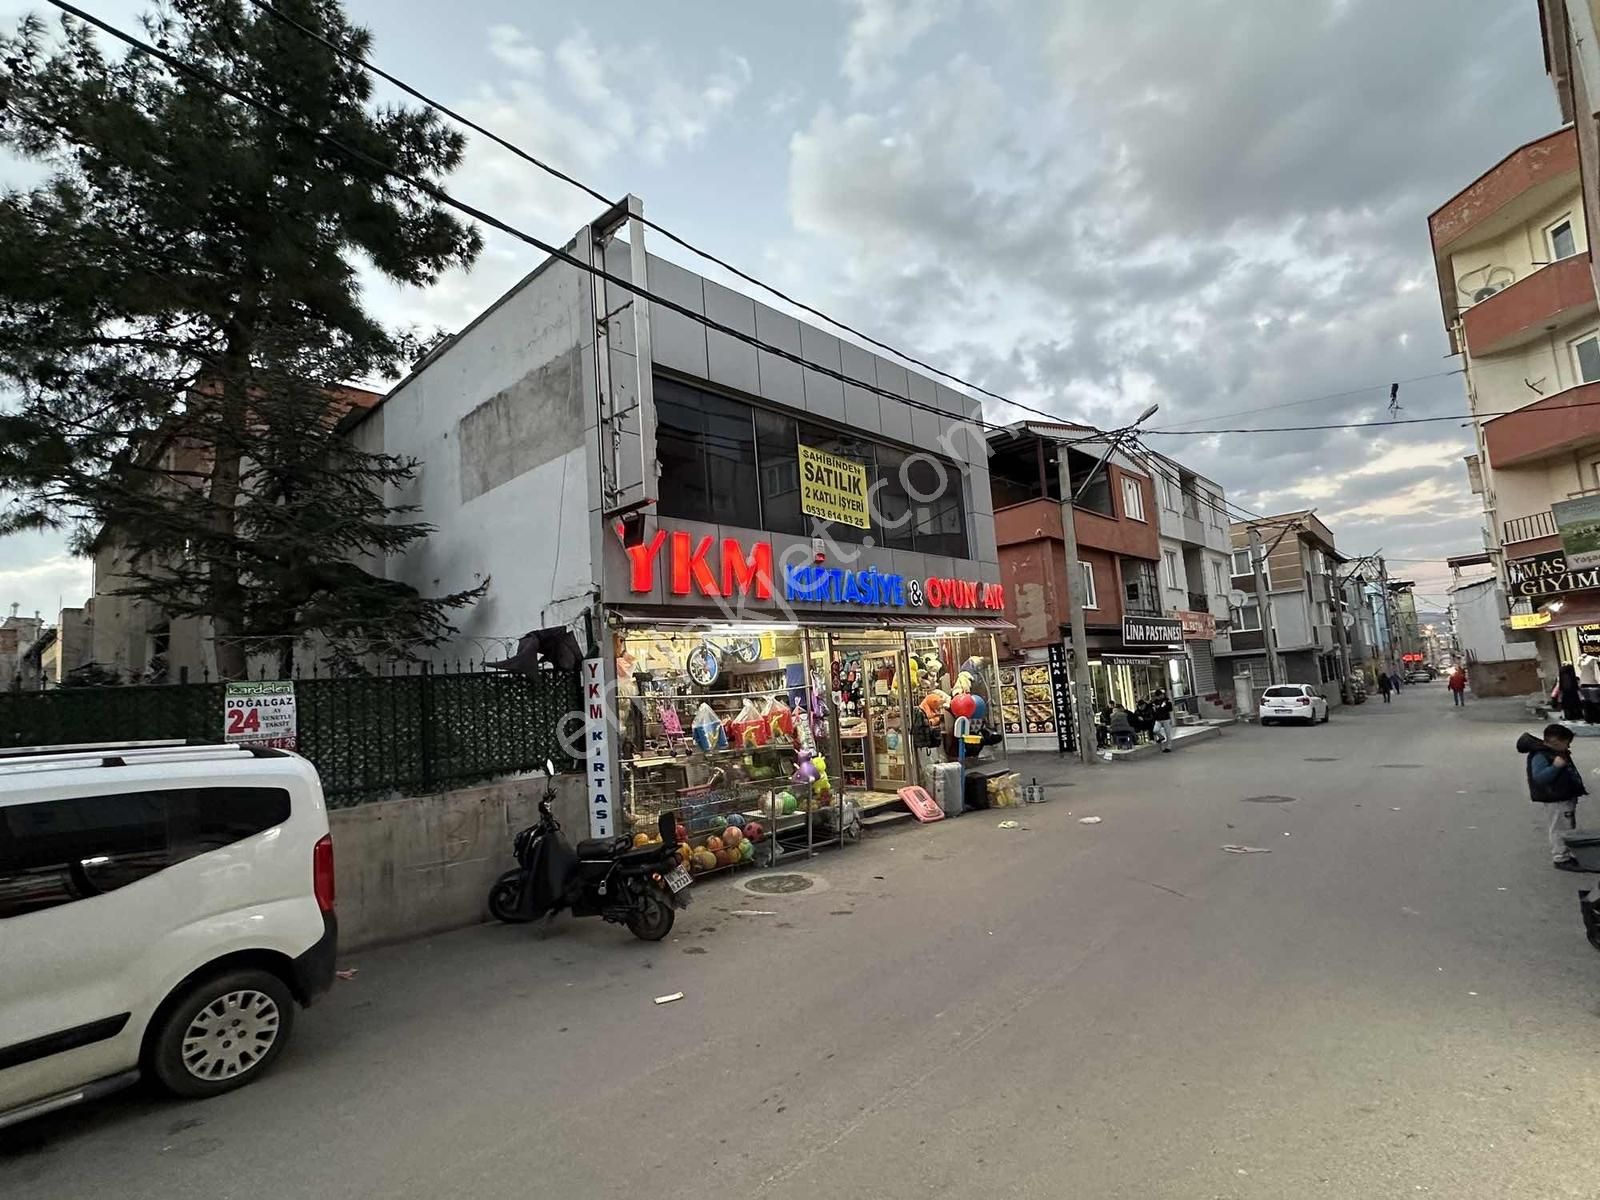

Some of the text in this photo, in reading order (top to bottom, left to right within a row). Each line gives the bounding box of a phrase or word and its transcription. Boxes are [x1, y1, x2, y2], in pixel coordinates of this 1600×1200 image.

[802, 449, 861, 475] SAHİBİNDEN
[803, 461, 863, 497] SATILIK
[805, 486, 865, 513] 2 KATLI İŞYERİ
[806, 505, 864, 526] 0533 614 83 25
[614, 523, 773, 600] YKM
[1523, 557, 1567, 579] MAS
[786, 564, 906, 607] KIRTASİYE
[910, 579, 923, 608] &
[1519, 566, 1600, 595] GİYİM
[1125, 620, 1183, 641] LİNA PASTANESİ
[228, 698, 293, 708] DOĞALGAZ
[588, 663, 603, 719] YKM
[227, 708, 261, 734] 24
